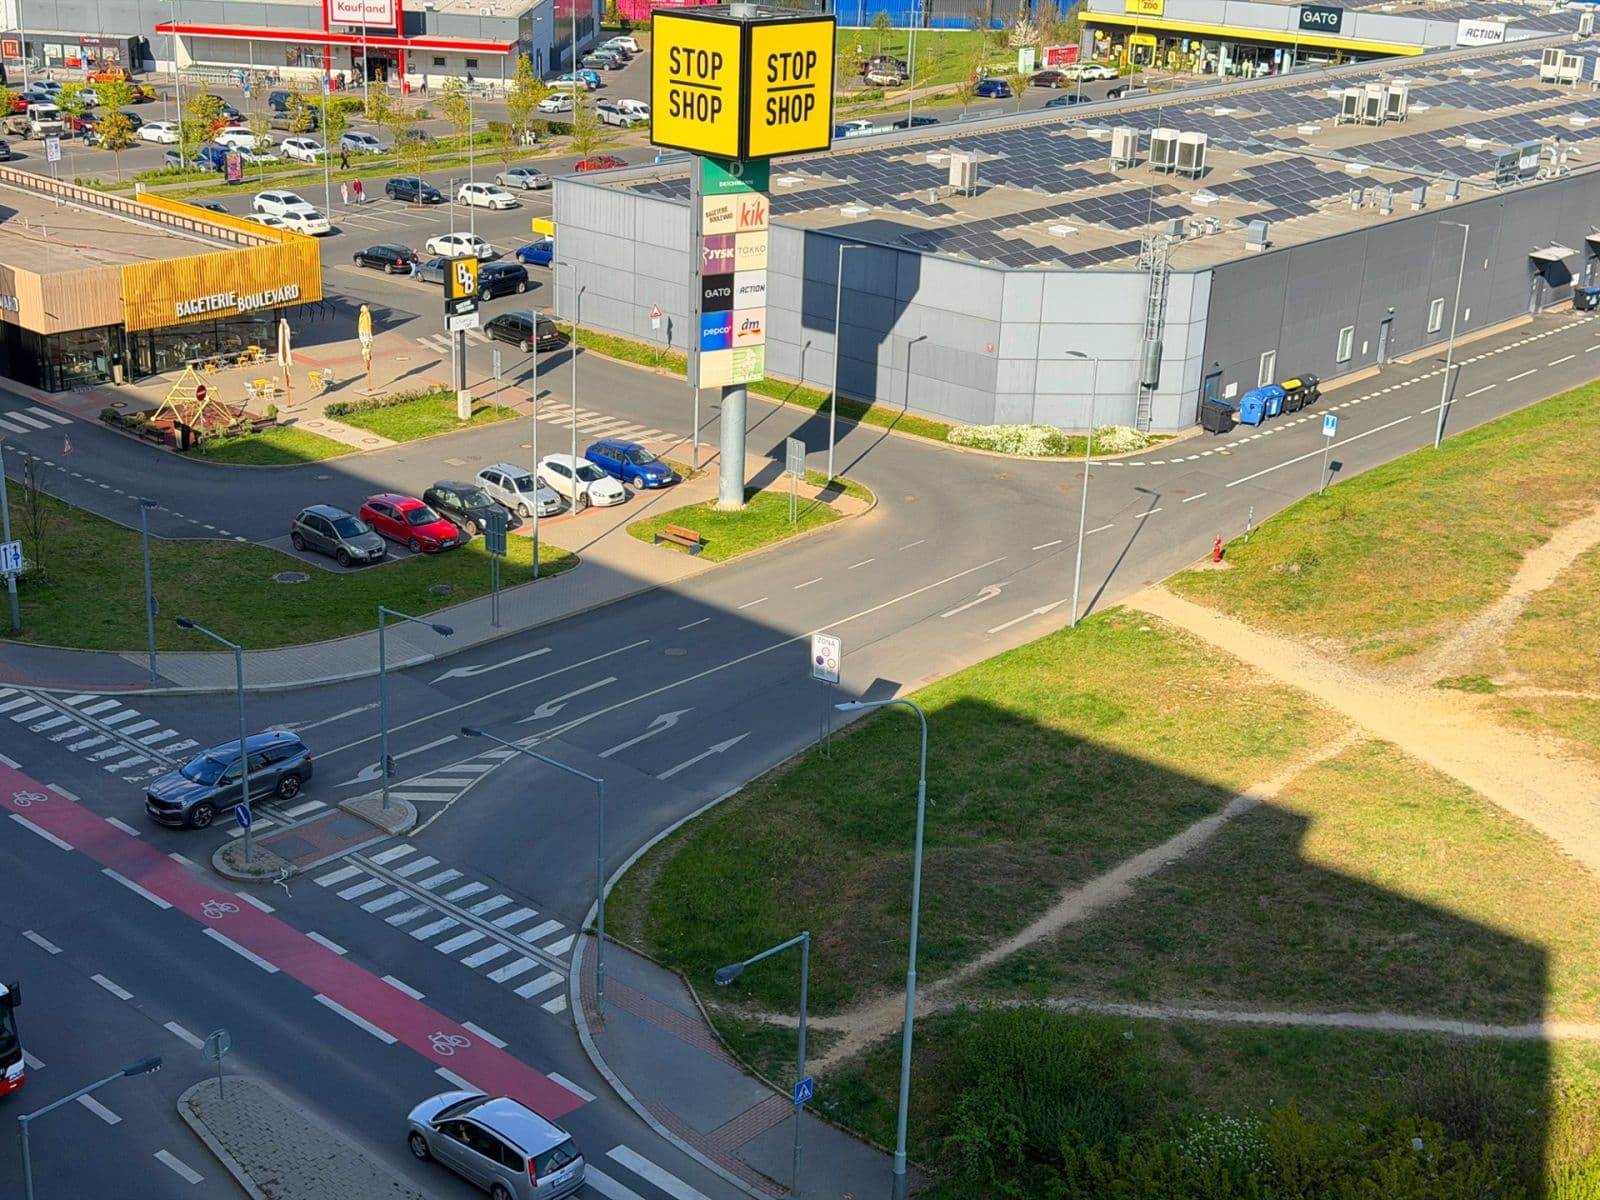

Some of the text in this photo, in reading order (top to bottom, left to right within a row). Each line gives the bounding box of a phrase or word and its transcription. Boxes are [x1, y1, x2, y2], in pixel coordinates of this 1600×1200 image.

[338, 1, 386, 14] Kaufand
[1465, 28, 1502, 40] ACTION
[669, 46, 723, 80] STOP
[767, 50, 817, 83] STOP
[669, 89, 722, 124] SHOP
[766, 93, 815, 126] SHOP
[708, 248, 735, 260] JYSK
[739, 284, 766, 295] ACTION
[176, 284, 299, 318] BAGETERIE BOULEVARD
[741, 318, 760, 331] dm
[703, 327, 730, 337] pepco
